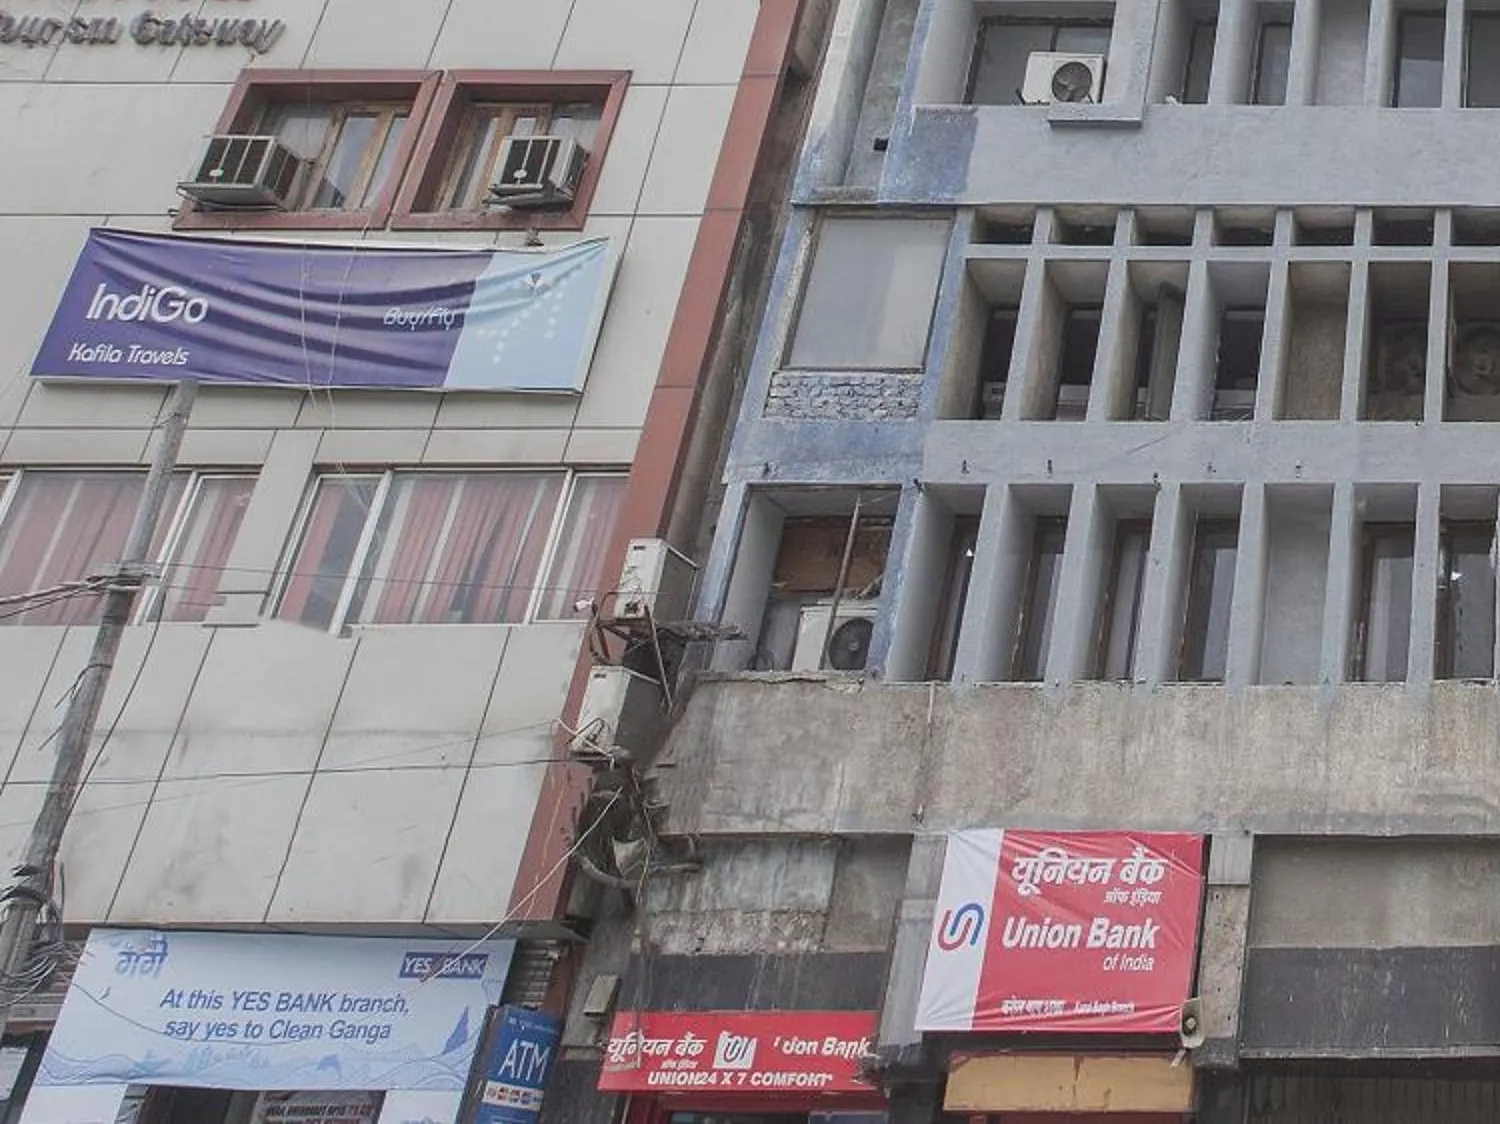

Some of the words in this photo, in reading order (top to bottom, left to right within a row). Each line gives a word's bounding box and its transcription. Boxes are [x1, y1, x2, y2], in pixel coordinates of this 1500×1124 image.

[86, 283, 209, 323] IndiGo
[68, 343, 123, 363] Kafila
[126, 345, 190, 365] Travels
[1011, 846, 1119, 897] यूनियन
[1119, 844, 1170, 885] बैंक
[1002, 915, 1081, 949] Union
[1086, 916, 1160, 950] Bank
[404, 957, 432, 973] YES
[1103, 955, 1118, 971] of
[1119, 954, 1154, 972] India
[160, 989, 184, 1008] At
[187, 989, 223, 1010] this
[231, 991, 271, 1012] YES
[275, 993, 337, 1013] BANK
[164, 1020, 200, 1041] say
[205, 1023, 238, 1042] yes
[243, 1020, 262, 1039] to
[269, 1019, 323, 1040] Clean
[328, 1020, 391, 1045] Ganga
[498, 1037, 552, 1084] ATM
[721, 1072, 735, 1086] X
[737, 1073, 748, 1086] 7
